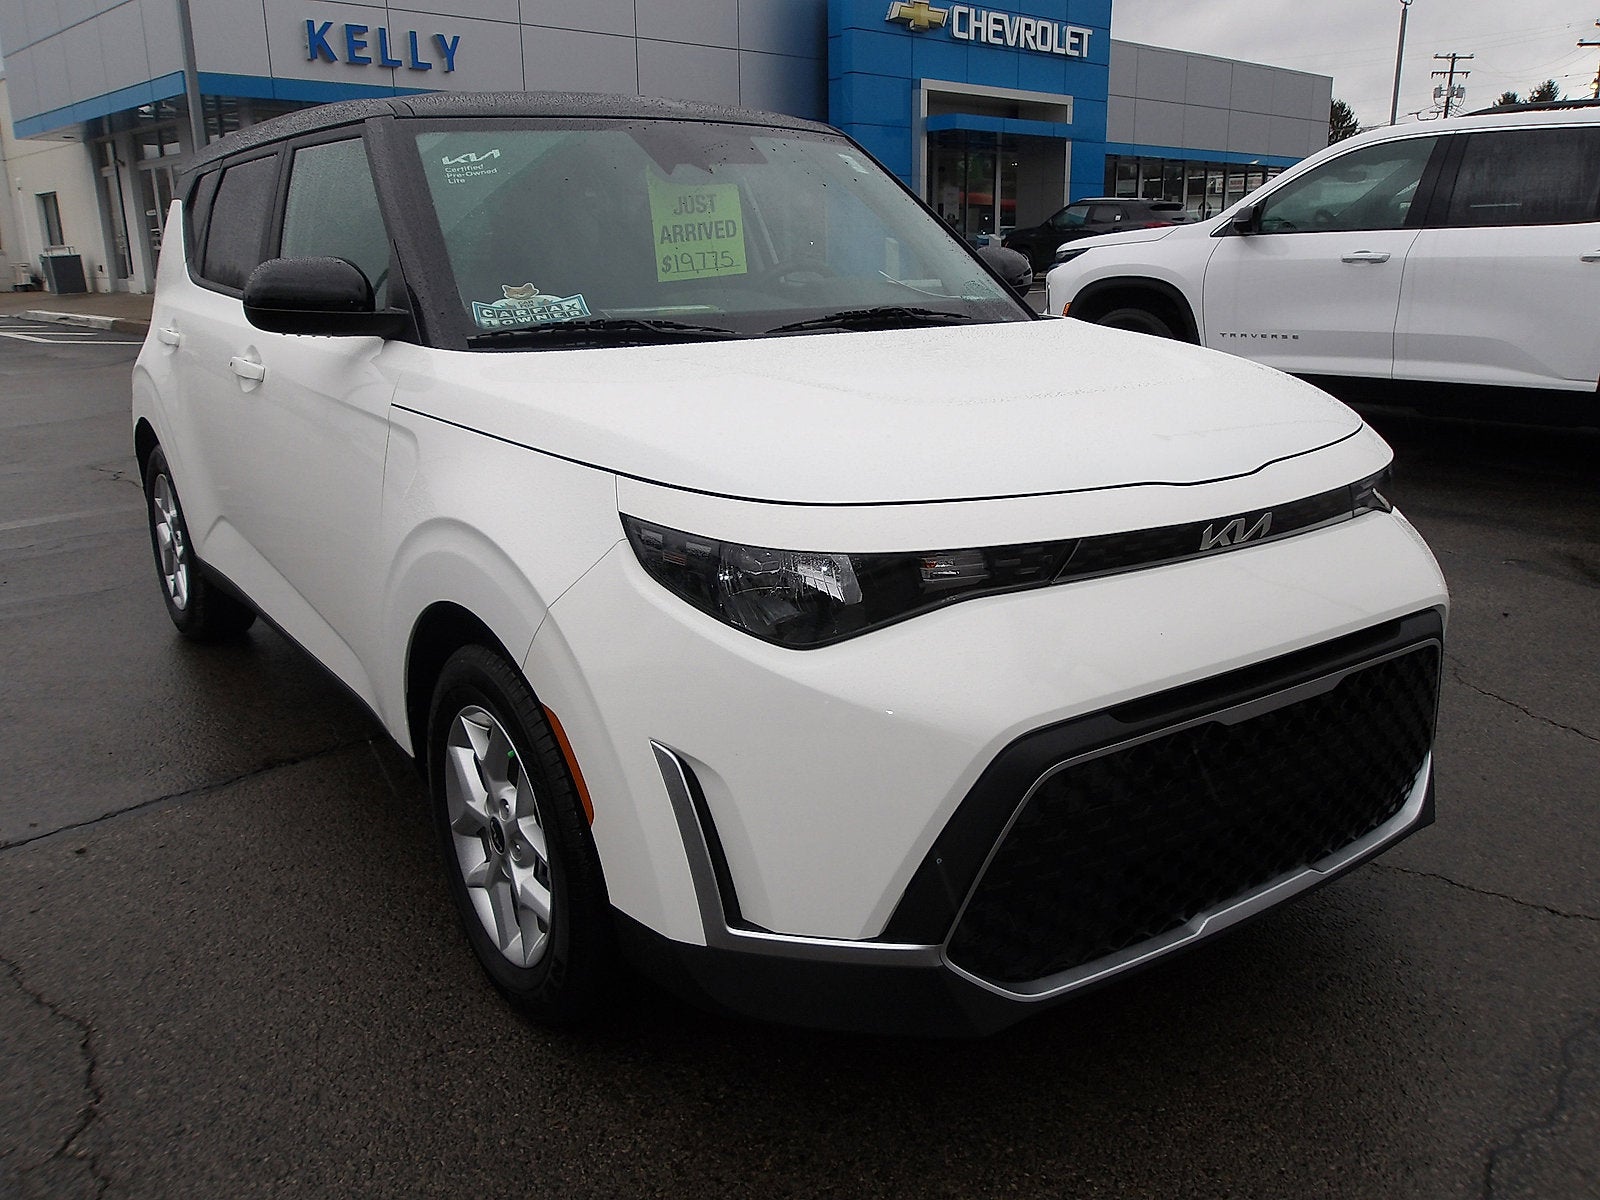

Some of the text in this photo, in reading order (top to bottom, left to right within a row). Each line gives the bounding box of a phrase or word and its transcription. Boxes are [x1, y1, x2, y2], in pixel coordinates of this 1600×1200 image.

[951, 5, 1093, 58] CHEVROLET
[305, 19, 460, 73] KELLY
[442, 149, 500, 164] KIA
[445, 164, 484, 173] Certified
[446, 168, 498, 178] Pre-Owned
[673, 194, 717, 215] JUST
[660, 220, 737, 244] ARRIVED
[482, 303, 577, 318] CARFAX
[502, 311, 581, 326] OWNER
[1220, 332, 1299, 340] TRAVERSE
[1199, 512, 1272, 550] KIA
